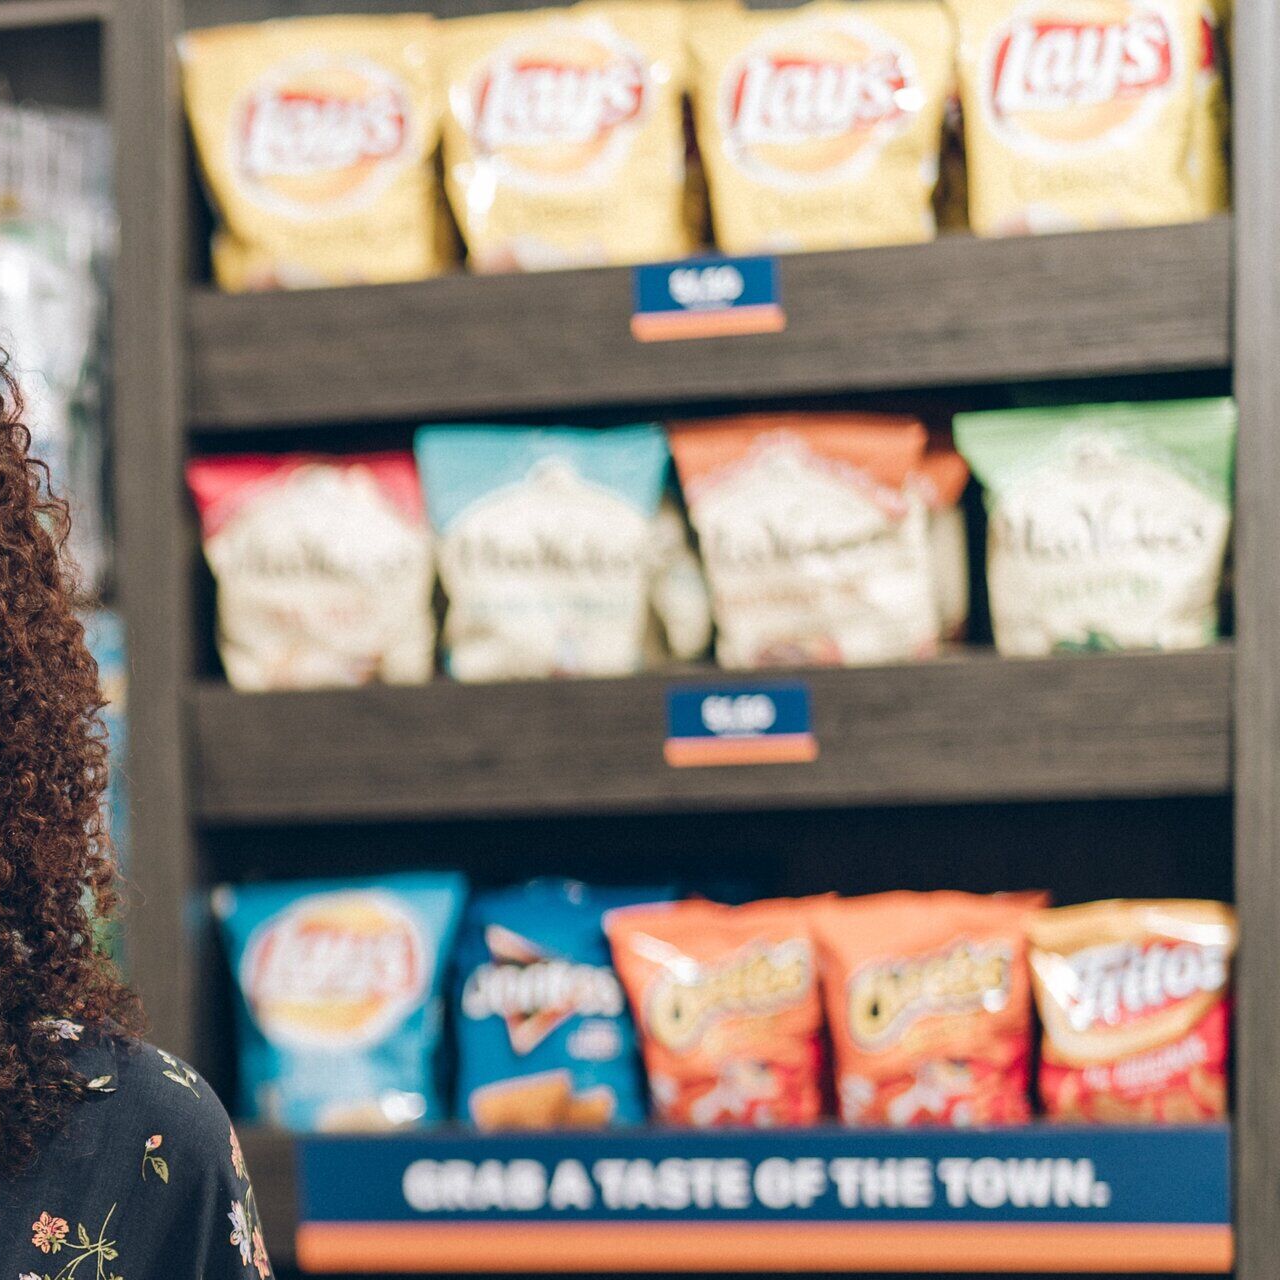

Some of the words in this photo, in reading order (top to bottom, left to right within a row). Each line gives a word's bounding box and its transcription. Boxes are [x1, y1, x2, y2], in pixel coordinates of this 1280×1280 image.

[997, 15, 1172, 114] Lay's
[403, 1159, 547, 1211] GRAB
[550, 1158, 593, 1210] A
[593, 1158, 751, 1209] TASTE
[754, 1157, 826, 1209] OF
[829, 1157, 933, 1209] THE
[937, 1157, 1111, 1209] TOWN.
